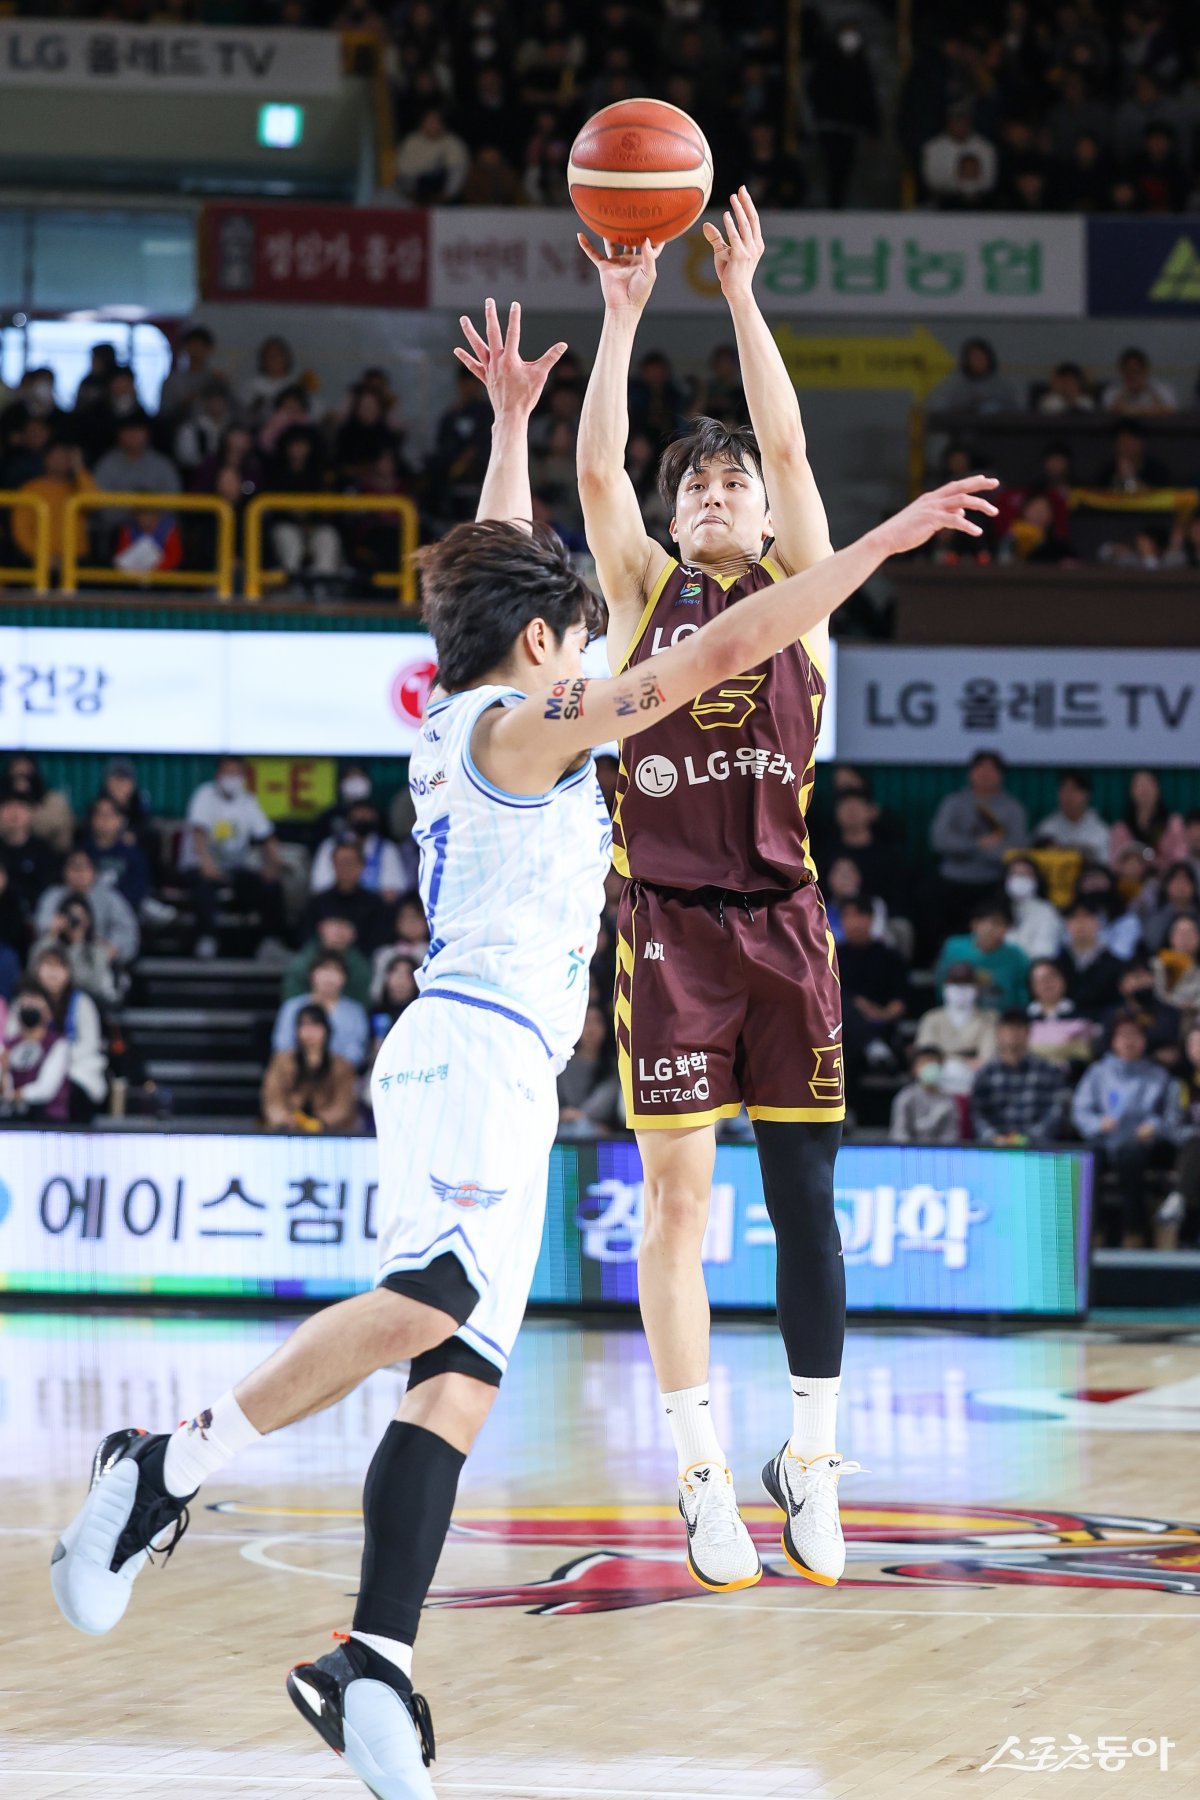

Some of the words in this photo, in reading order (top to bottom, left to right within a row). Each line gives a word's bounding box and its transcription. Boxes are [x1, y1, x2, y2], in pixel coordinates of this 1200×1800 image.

[8, 34, 70, 71] LG
[216, 40, 276, 77] TV
[763, 235, 1043, 297] 경남농협
[0, 663, 107, 715] 건강
[864, 680, 937, 728] LG
[959, 677, 1108, 731] 올레드
[1117, 683, 1193, 730] TV
